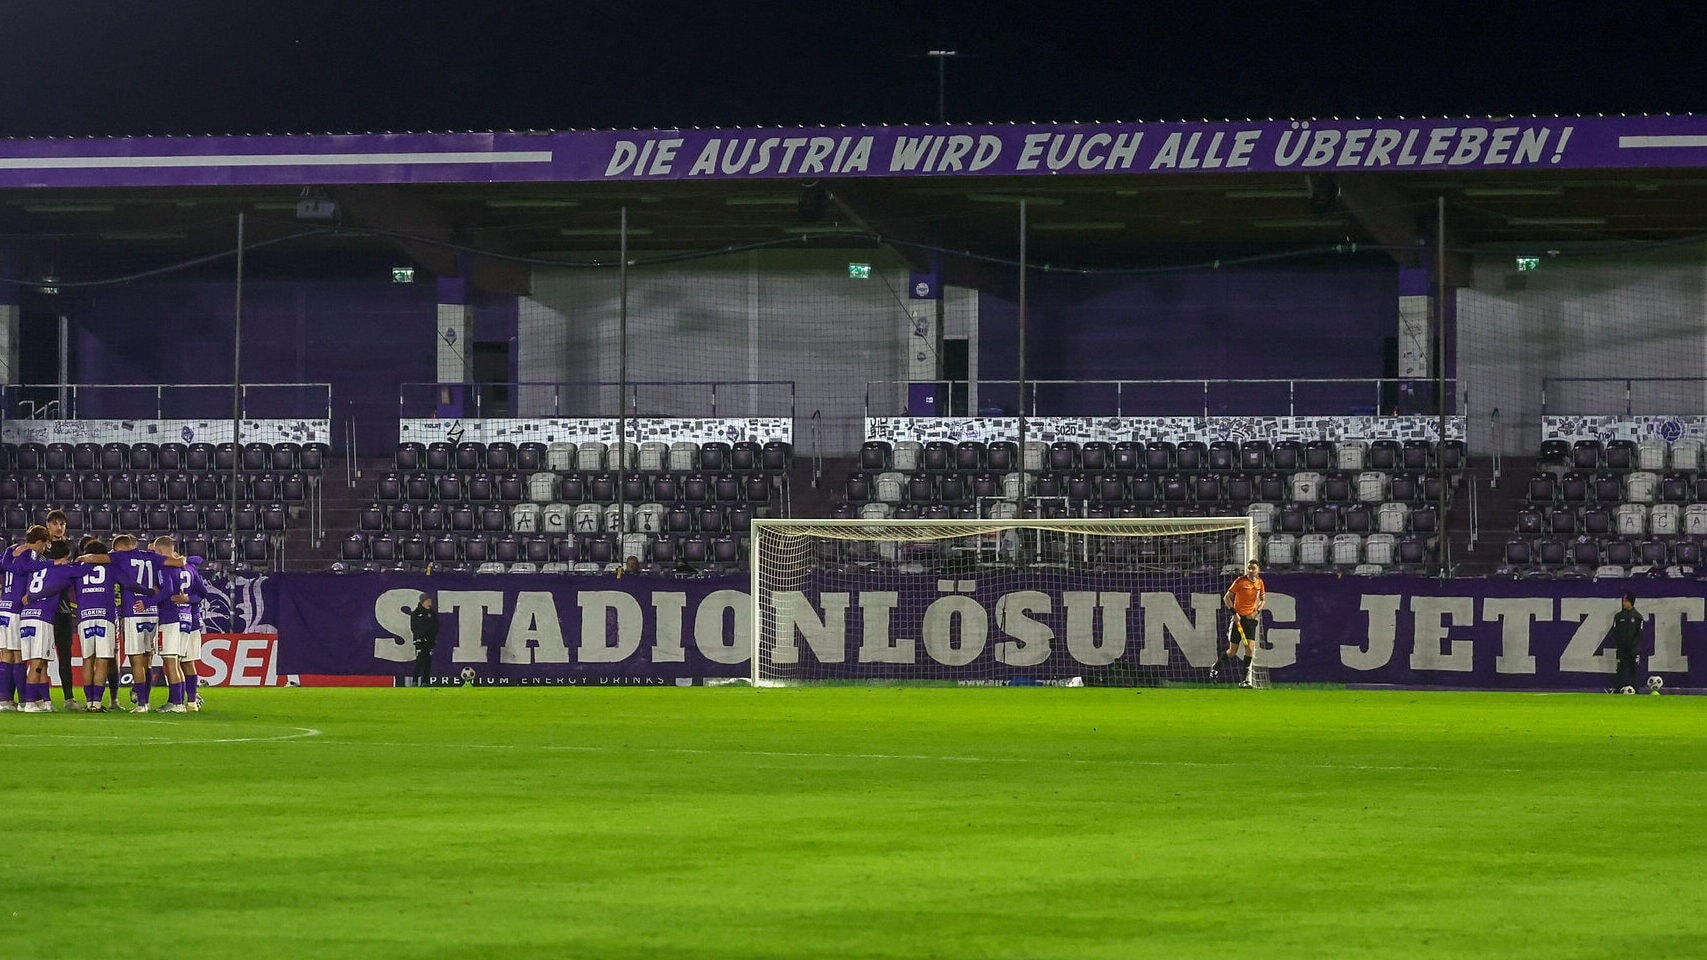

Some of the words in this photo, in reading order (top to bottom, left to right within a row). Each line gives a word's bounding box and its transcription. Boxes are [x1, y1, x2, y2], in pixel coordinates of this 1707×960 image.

[605, 138, 684, 177] DIE
[688, 135, 875, 177] AUSTRIA
[889, 134, 1003, 173] WIRD
[1016, 131, 1144, 172] EUCH
[1150, 129, 1261, 170] ALLE
[1274, 120, 1574, 168] ÜBERLEBEN!
[1055, 425, 1077, 436] 5020
[29, 567, 48, 593] 8
[131, 558, 154, 589] 71
[373, 579, 1301, 668] STADIONLÖSUNG
[1340, 594, 1705, 674] JETZT
[429, 676, 510, 685] PREIUM
[599, 676, 665, 685] DRINKS
